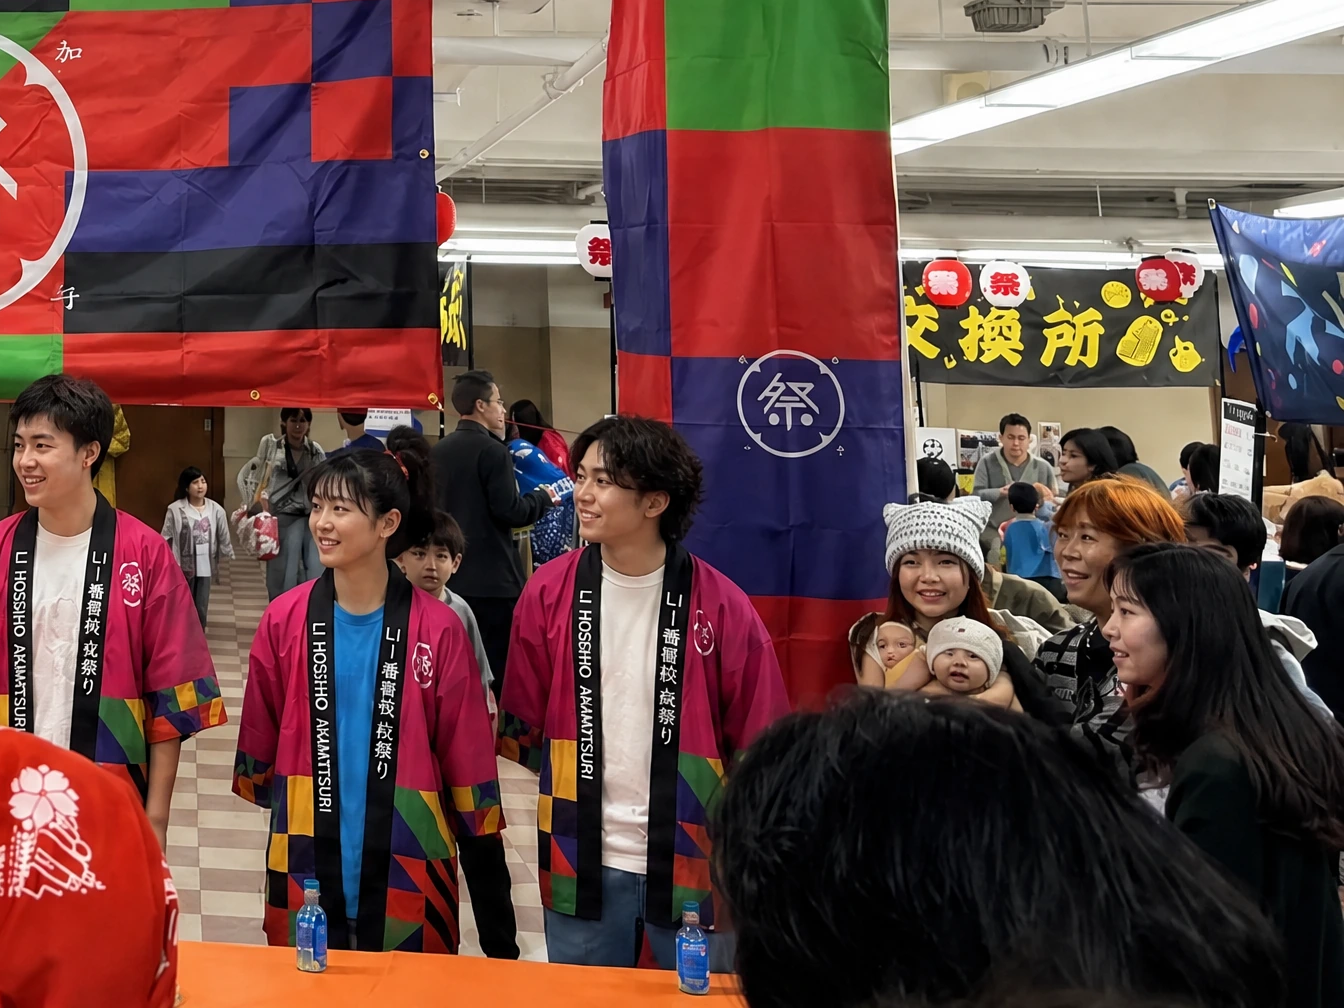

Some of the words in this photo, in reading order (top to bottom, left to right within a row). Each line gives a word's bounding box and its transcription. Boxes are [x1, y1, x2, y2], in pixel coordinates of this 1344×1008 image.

[55, 39, 82, 63] 加
[990, 272, 1021, 296] 祭
[757, 372, 820, 432] 祭
[15, 551, 28, 564] LI
[579, 589, 593, 604] LI
[312, 622, 326, 636] LI
